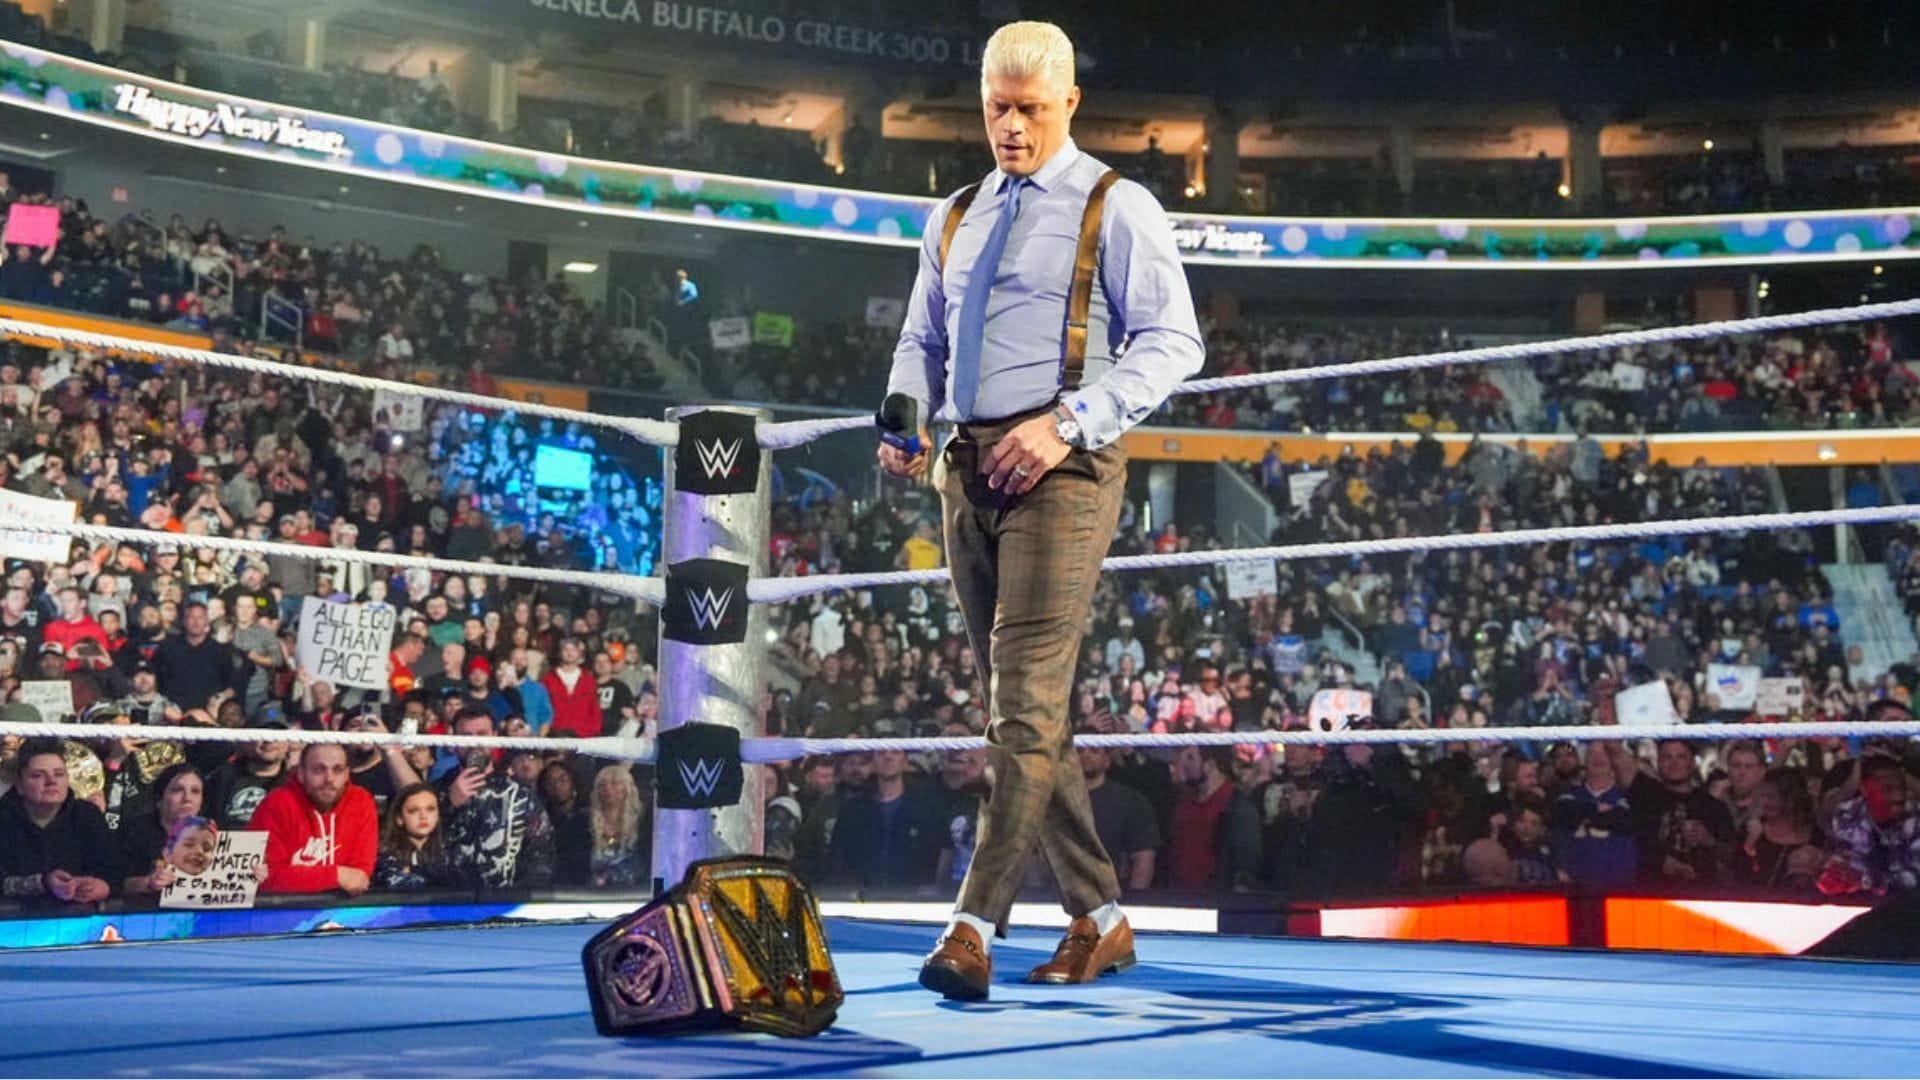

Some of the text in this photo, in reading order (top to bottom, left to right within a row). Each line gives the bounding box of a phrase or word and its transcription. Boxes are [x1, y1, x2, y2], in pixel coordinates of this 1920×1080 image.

[532, 0, 641, 23] NECA
[652, 2, 786, 43] BUFFALO
[795, 20, 886, 55] CREEK
[892, 33, 950, 63] 300
[113, 84, 216, 136] Happy
[214, 103, 278, 142] New
[313, 602, 394, 631] ALL EGO
[312, 621, 382, 652] ETHAN
[317, 647, 379, 684] PAGE
[216, 832, 233, 854] HI
[212, 853, 261, 872] MATEO
